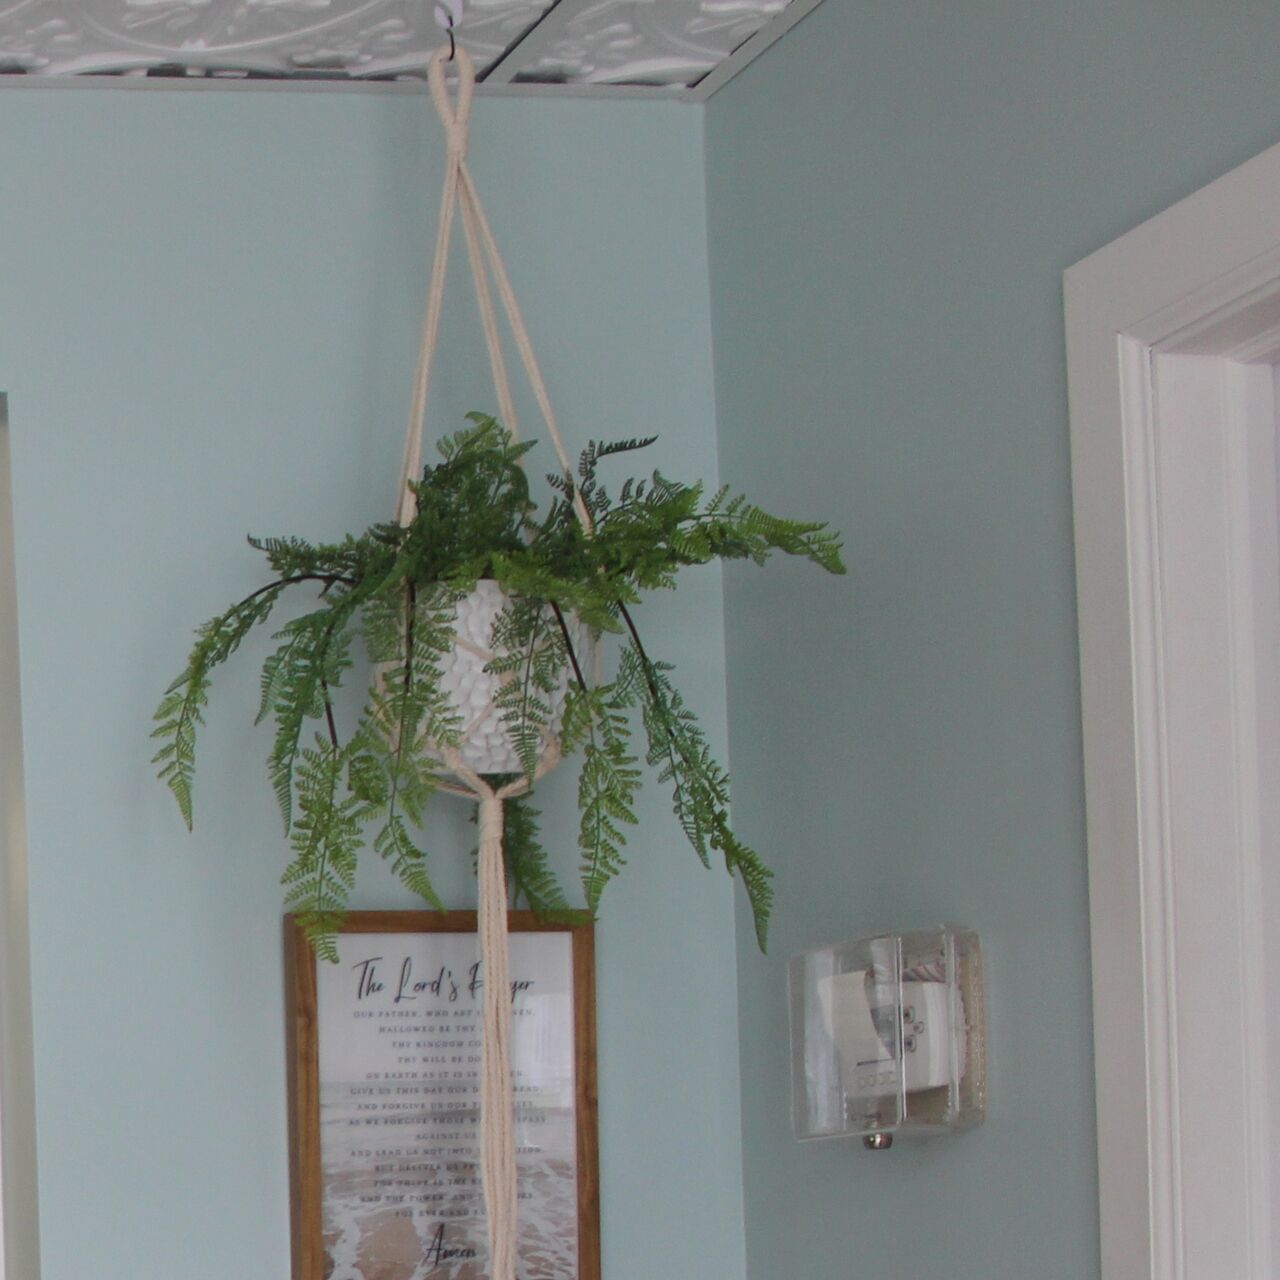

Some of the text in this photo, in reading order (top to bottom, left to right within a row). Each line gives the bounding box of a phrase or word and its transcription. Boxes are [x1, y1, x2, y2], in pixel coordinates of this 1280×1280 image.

[352, 956, 535, 1004] The Lord's Pyer
[353, 1009, 374, 1018] OUR
[425, 1009, 449, 1017] WHO
[453, 1009, 473, 1017] ART
[379, 1025, 435, 1033] HALLOWED
[439, 1025, 450, 1033] BE
[350, 1087, 374, 1095] GIVE
[383, 1117, 427, 1125] FORGIVE
[415, 1132, 460, 1140] AGAINST
[426, 1223, 476, 1267] Amen
